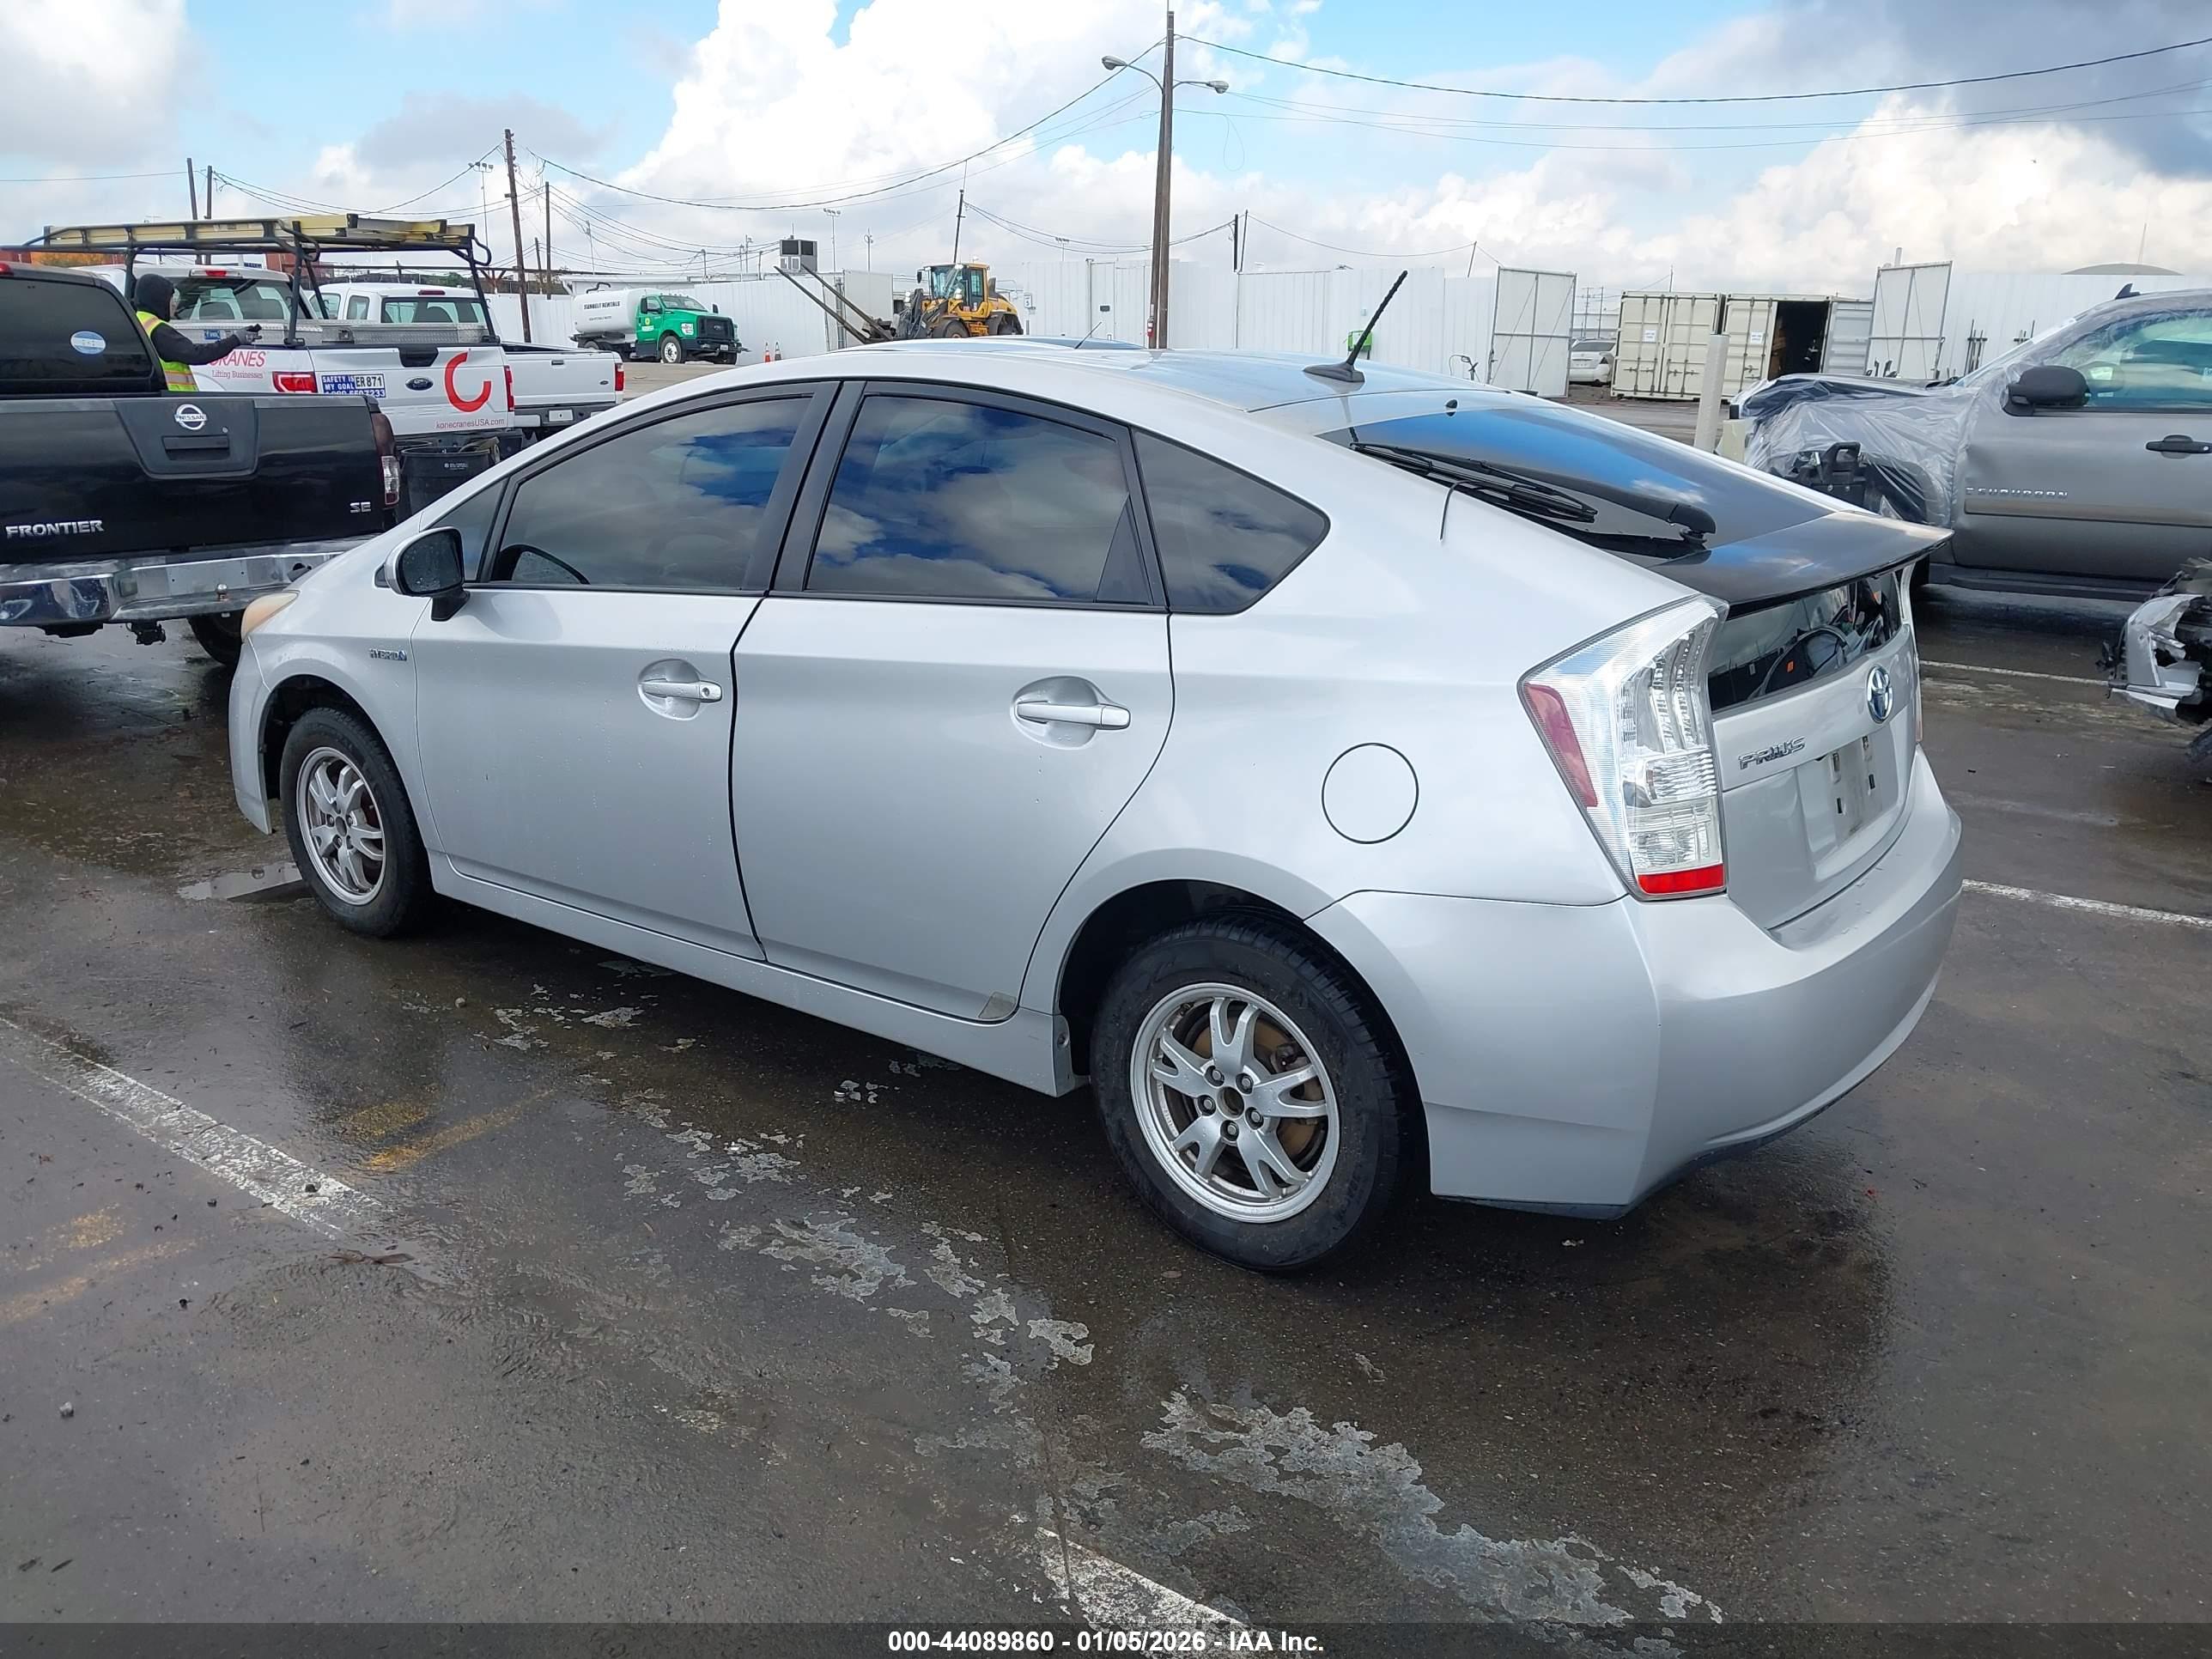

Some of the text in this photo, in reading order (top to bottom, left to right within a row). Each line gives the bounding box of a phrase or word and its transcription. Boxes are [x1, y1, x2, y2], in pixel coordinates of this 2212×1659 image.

[211, 370, 264, 380] Lifting Businesses
[435, 418, 505, 429] konecranesUSA.com
[349, 501, 372, 514] SE
[5, 520, 105, 539] FRONTIER
[1738, 735, 1806, 770] PRIUS
